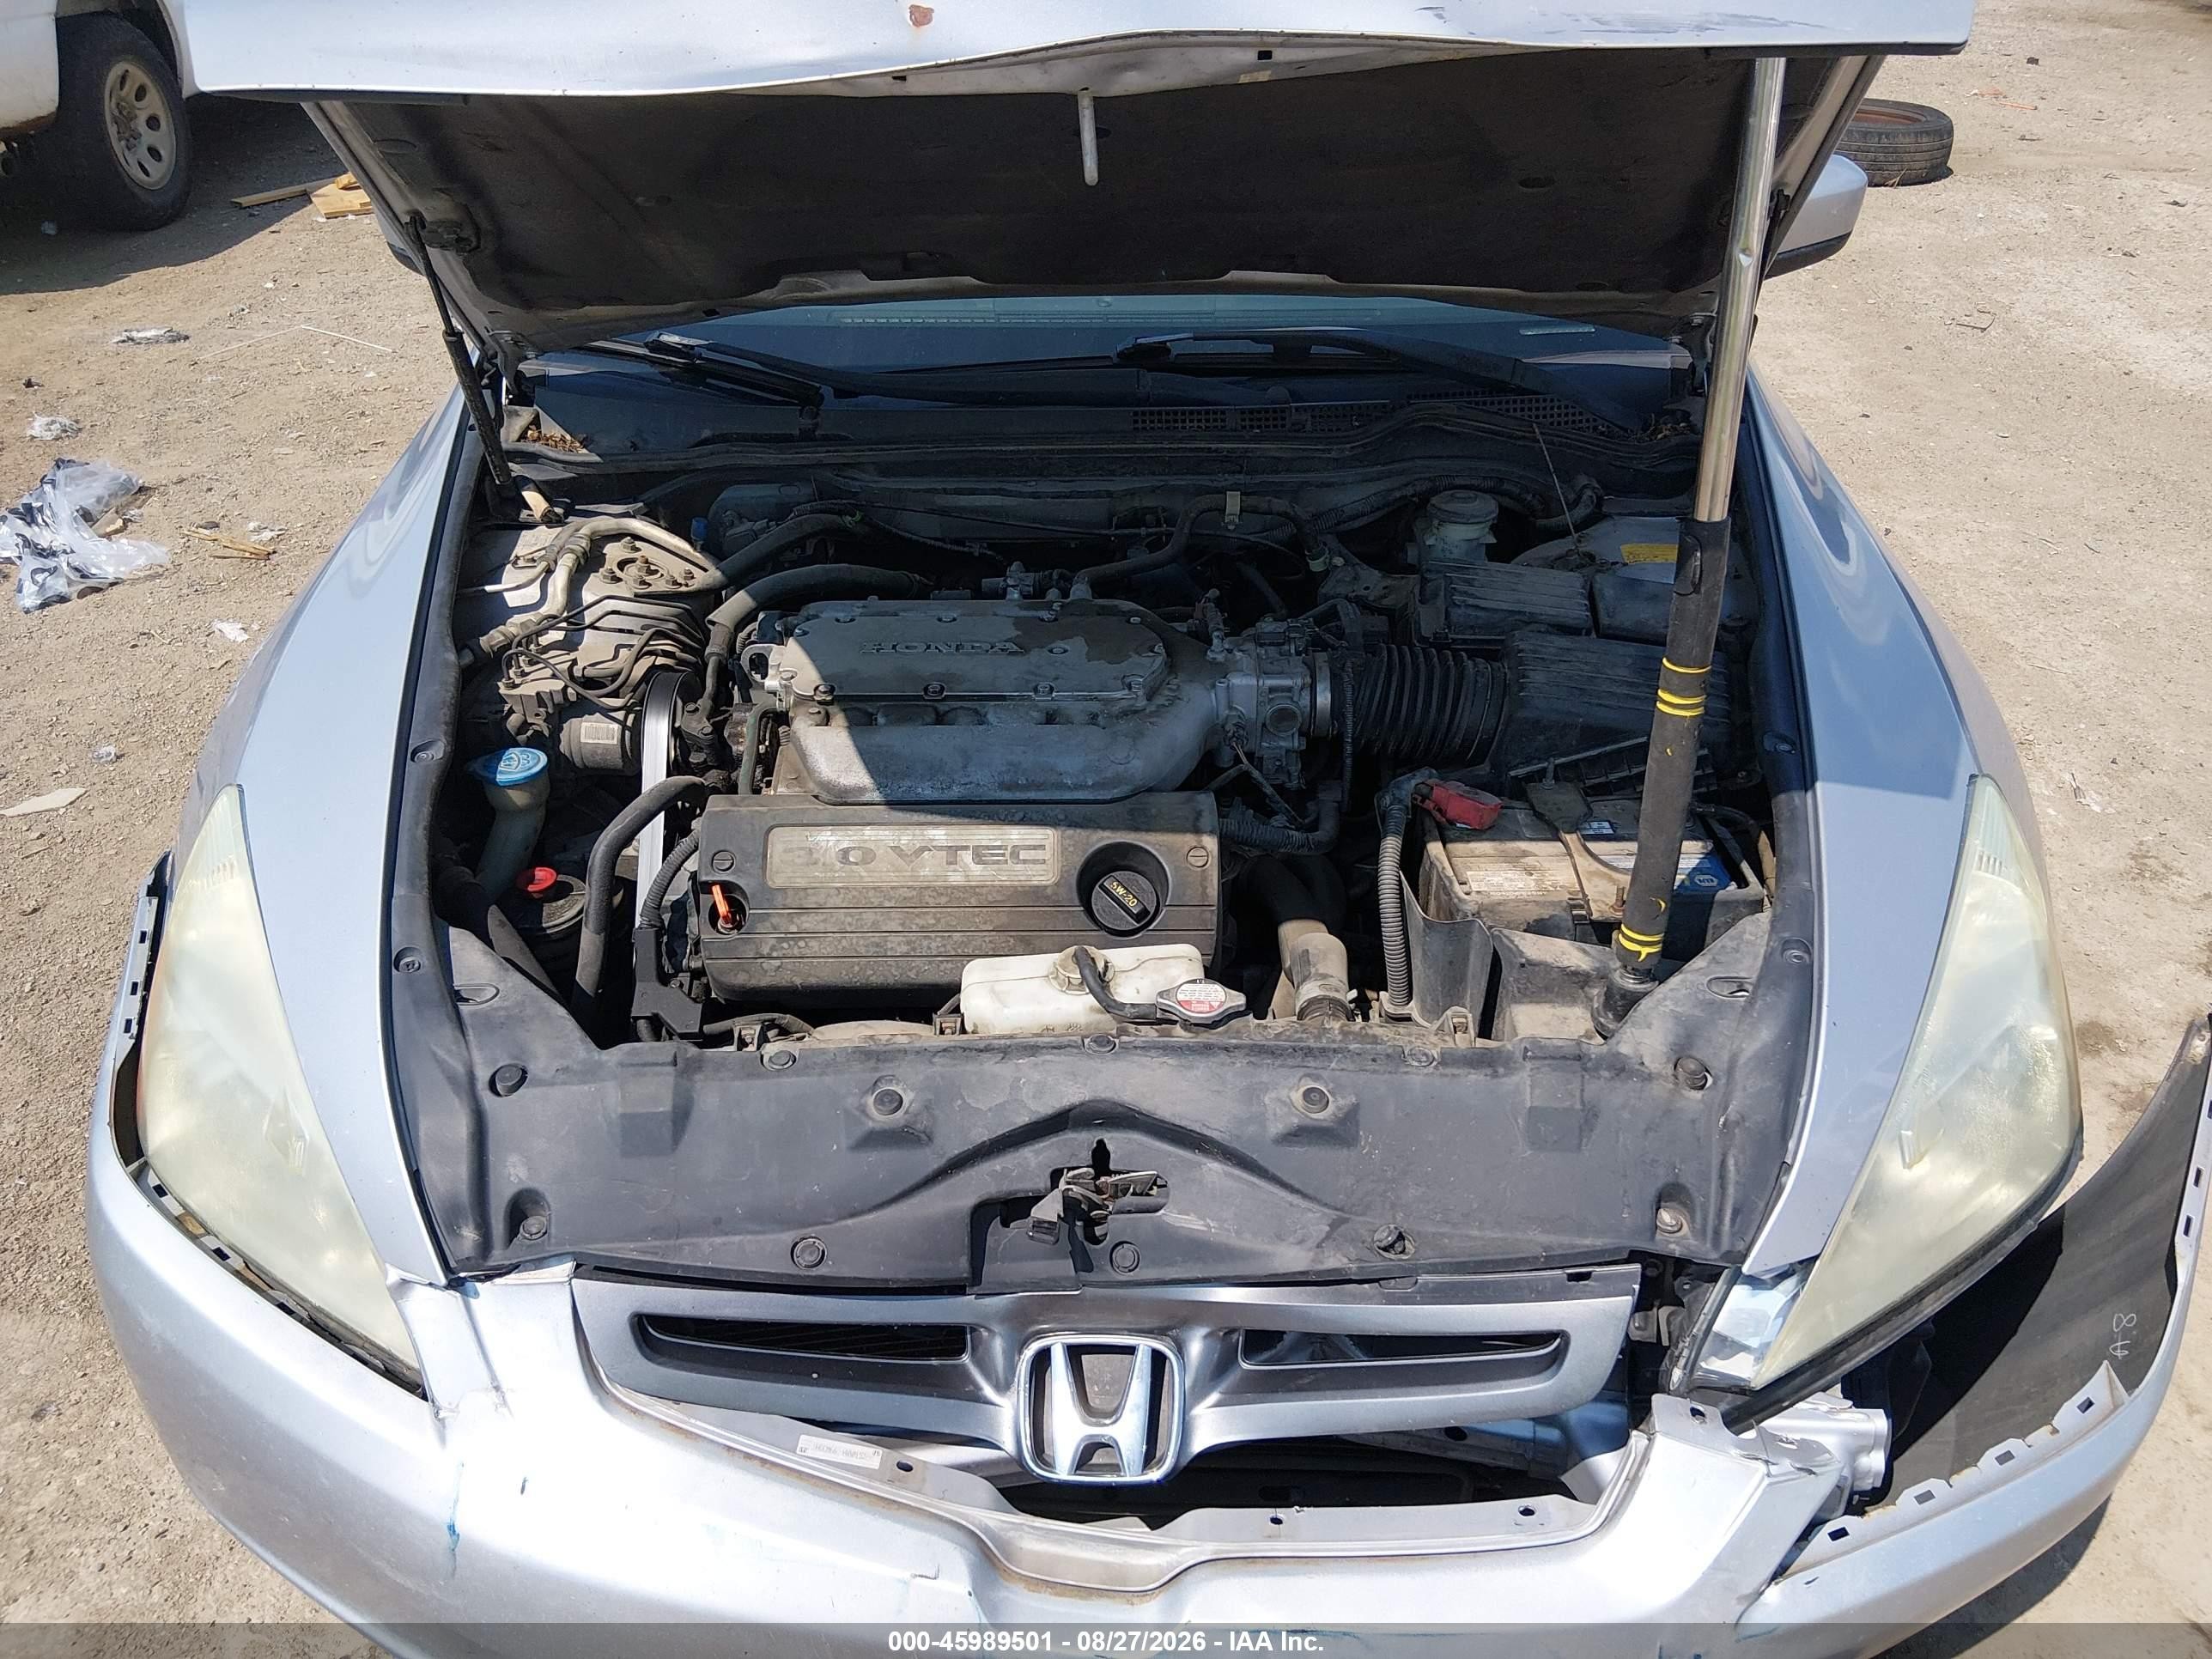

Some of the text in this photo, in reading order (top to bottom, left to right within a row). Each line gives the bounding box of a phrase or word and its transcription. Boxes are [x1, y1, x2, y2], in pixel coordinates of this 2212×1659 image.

[859, 641, 1025, 654] HONDA
[888, 844, 1047, 867] VTEC
[1109, 881, 1138, 907] 5W-20
